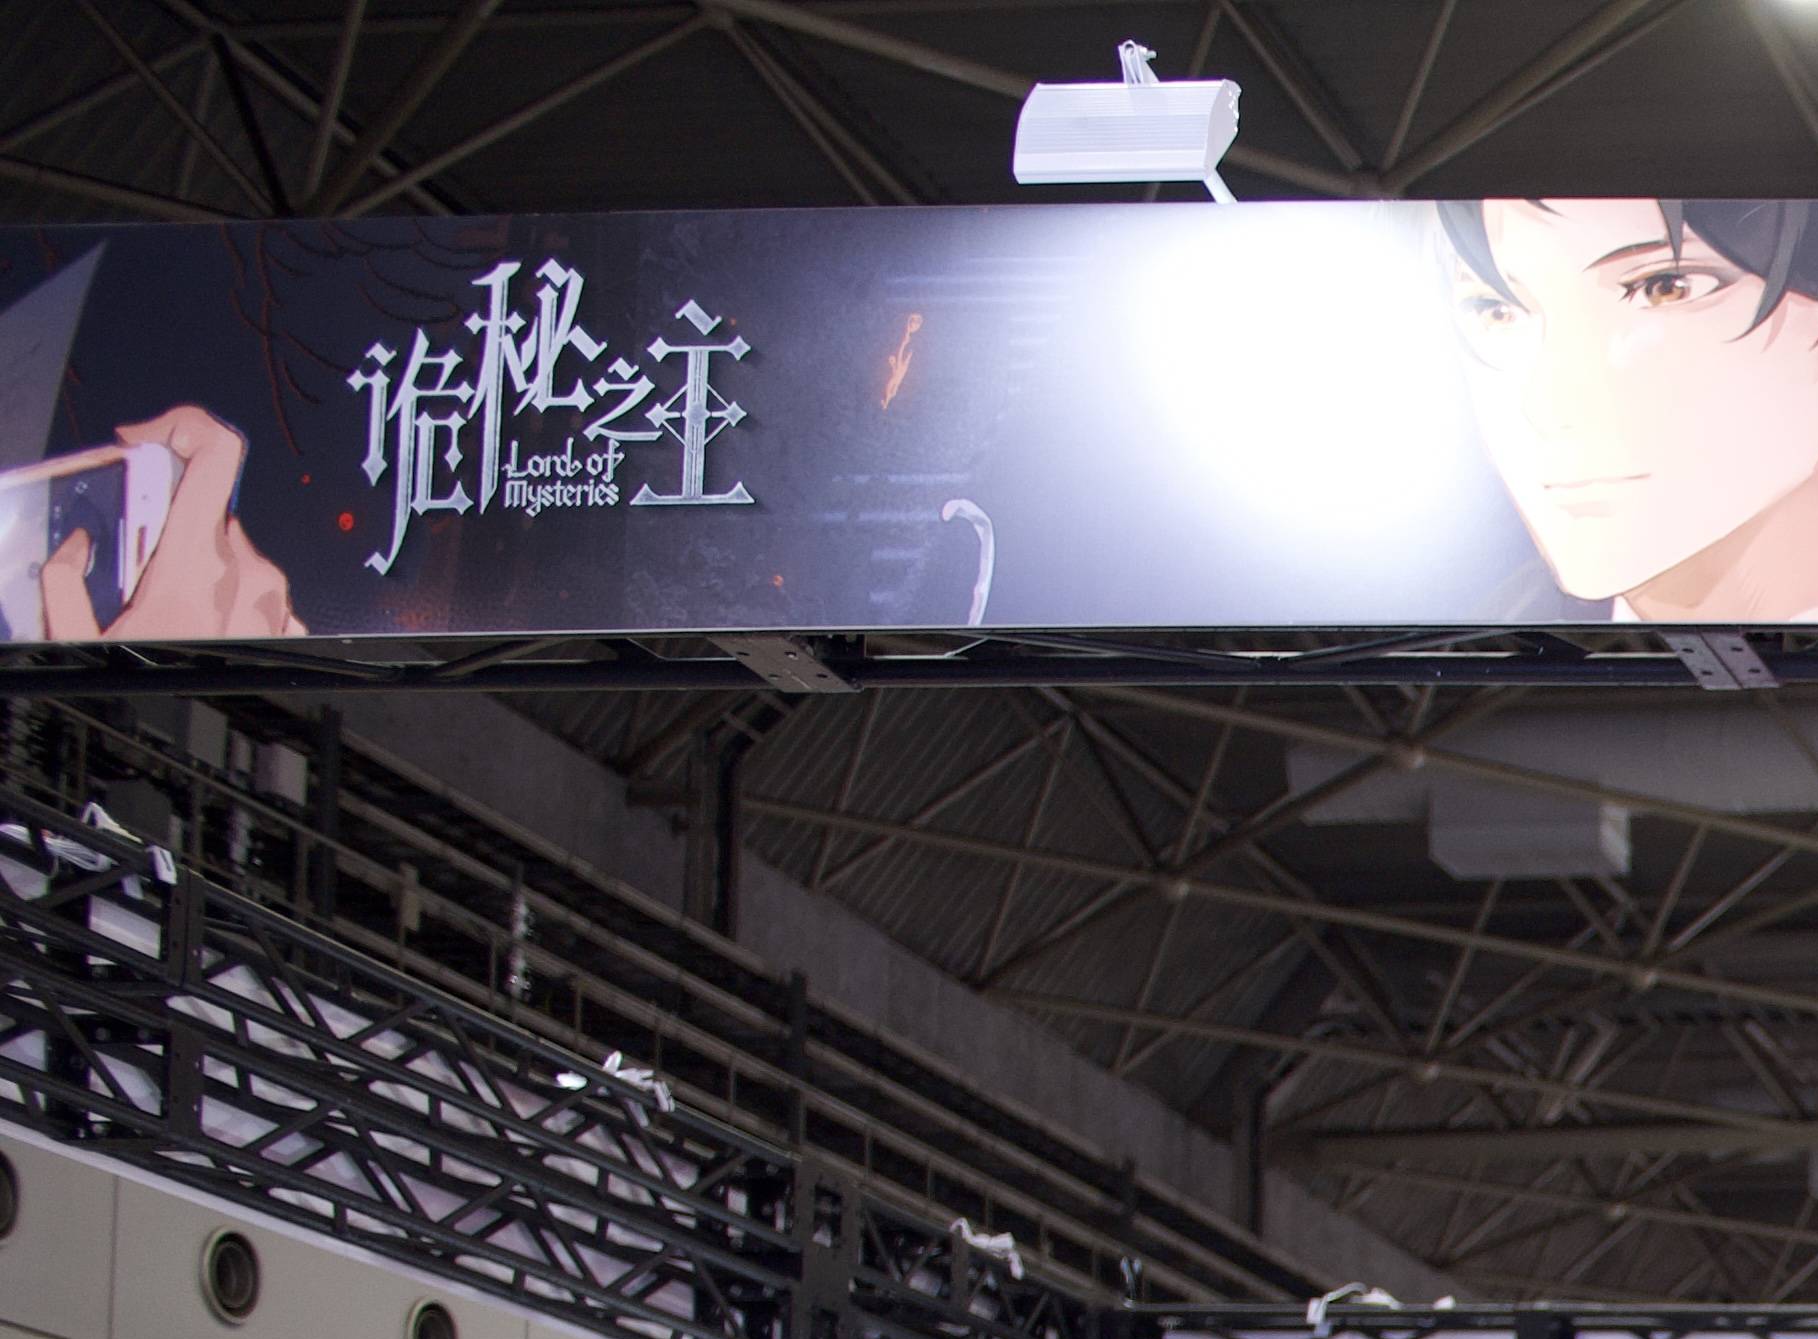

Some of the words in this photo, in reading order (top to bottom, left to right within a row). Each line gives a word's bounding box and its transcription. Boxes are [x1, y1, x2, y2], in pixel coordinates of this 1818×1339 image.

[347, 258, 755, 576] 诡秘之主
[502, 437, 583, 478] Lord
[585, 437, 625, 483] of
[503, 478, 620, 518] Mysteries
